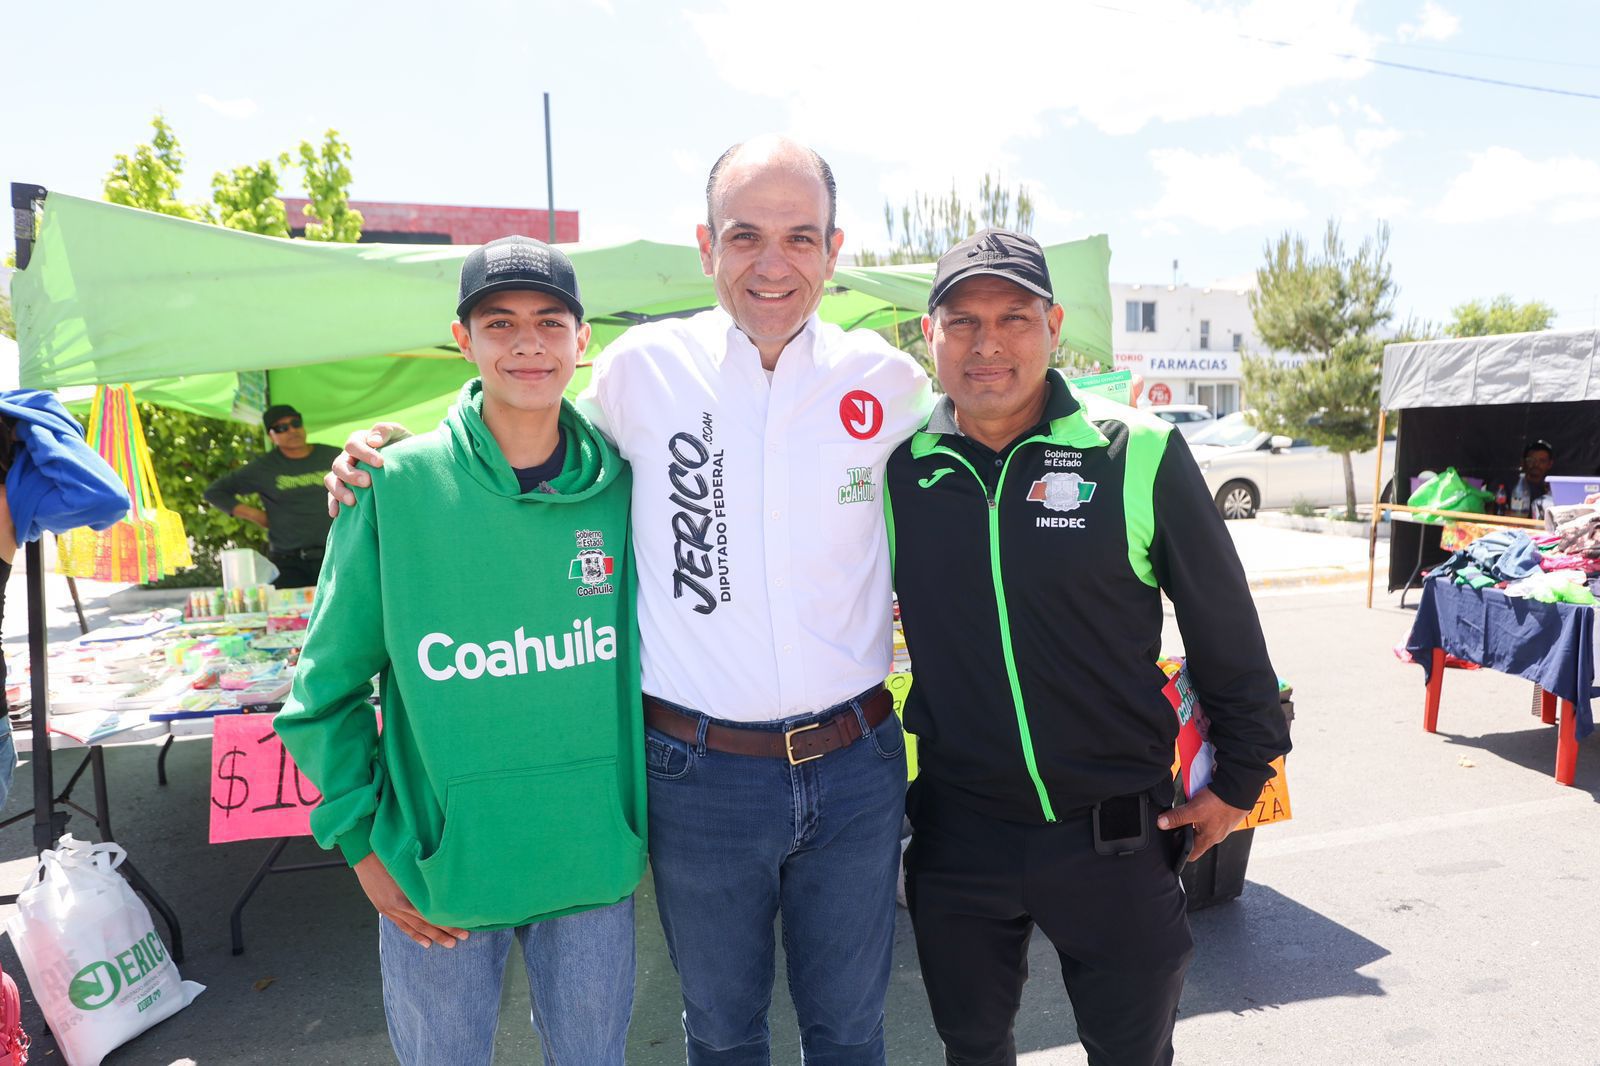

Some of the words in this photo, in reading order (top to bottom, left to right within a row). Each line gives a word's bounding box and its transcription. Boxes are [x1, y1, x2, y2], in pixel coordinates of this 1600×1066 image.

[1150, 358, 1228, 371] FARMACIAS
[1044, 449, 1083, 459] Gobierno
[1053, 458, 1082, 467] Estado
[712, 449, 725, 518] FEDERAL
[838, 485, 875, 505] COAHUIL
[668, 431, 717, 615] JERICO
[1036, 517, 1086, 528] INEDEC
[575, 529, 603, 539] Gobierno
[582, 538, 604, 548] Estado
[714, 523, 731, 602] DIPUTADO
[577, 583, 614, 597] Coahuila
[417, 616, 617, 681] Coahuila
